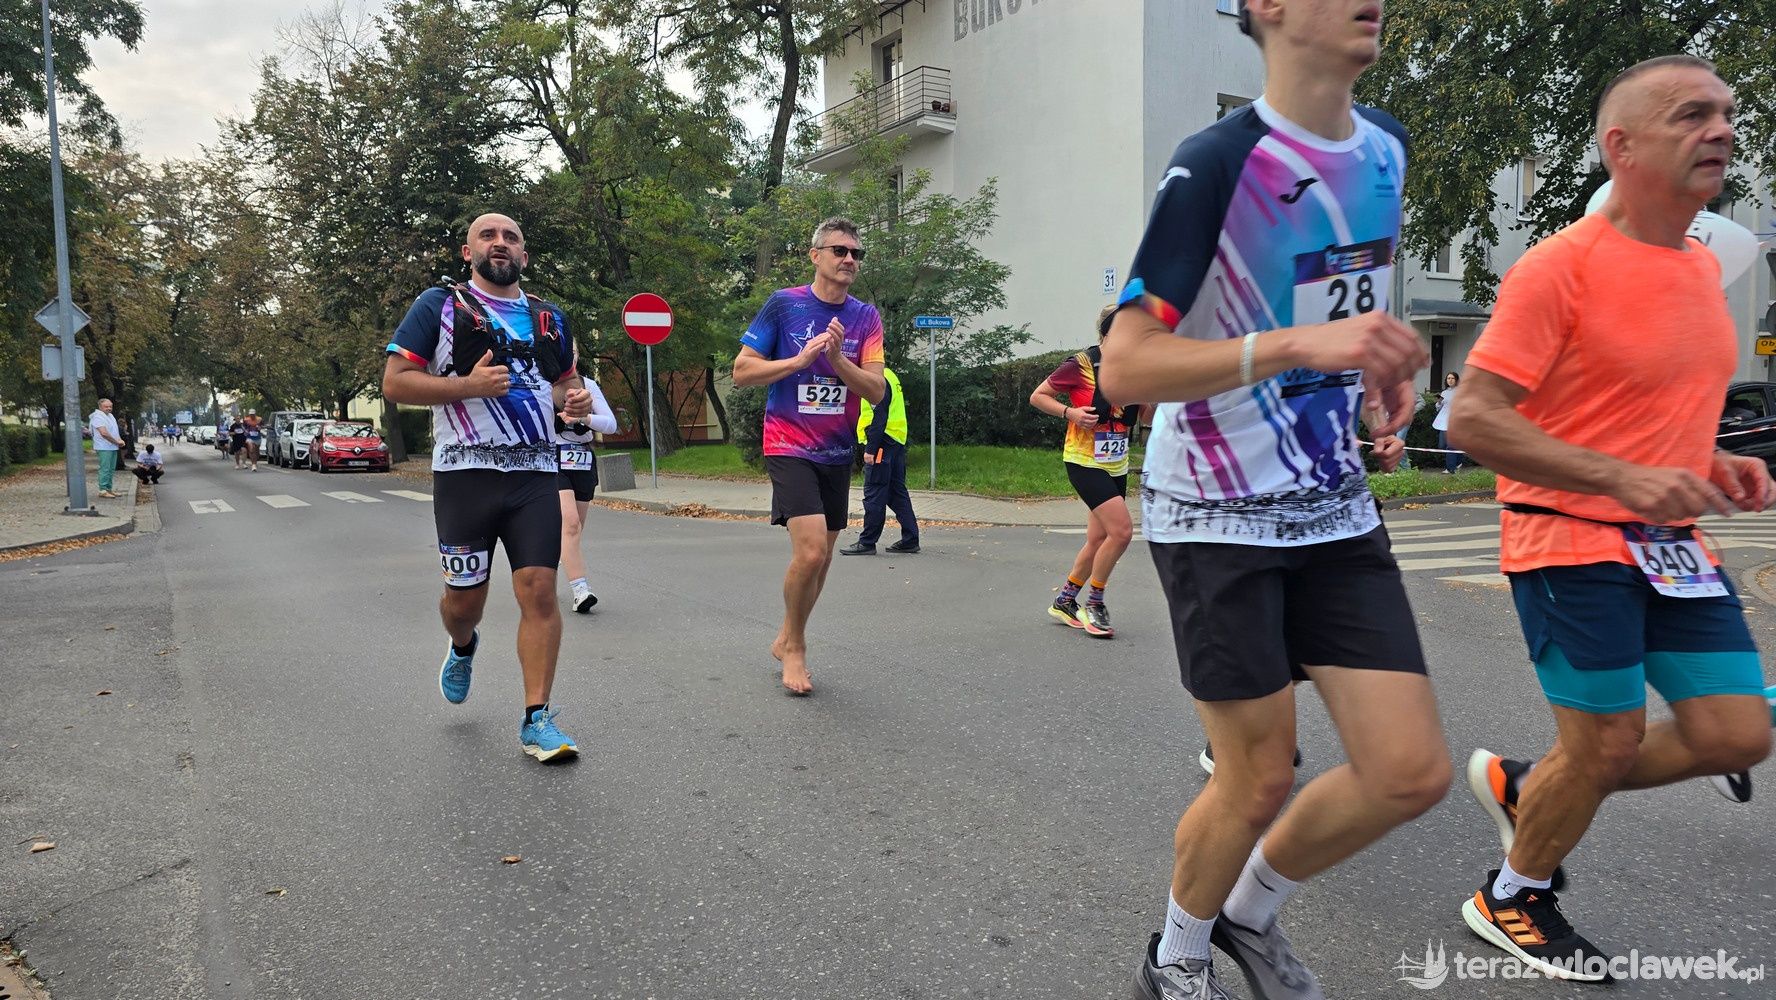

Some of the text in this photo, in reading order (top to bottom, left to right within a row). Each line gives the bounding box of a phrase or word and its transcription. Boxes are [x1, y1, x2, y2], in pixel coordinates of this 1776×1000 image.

[1104, 275, 1114, 287] 31
[1328, 273, 1376, 322] 28
[806, 386, 842, 402] 522
[1101, 440, 1125, 453] 428
[567, 451, 587, 463] 271
[442, 554, 480, 574] 400
[1641, 544, 1699, 575] 640
